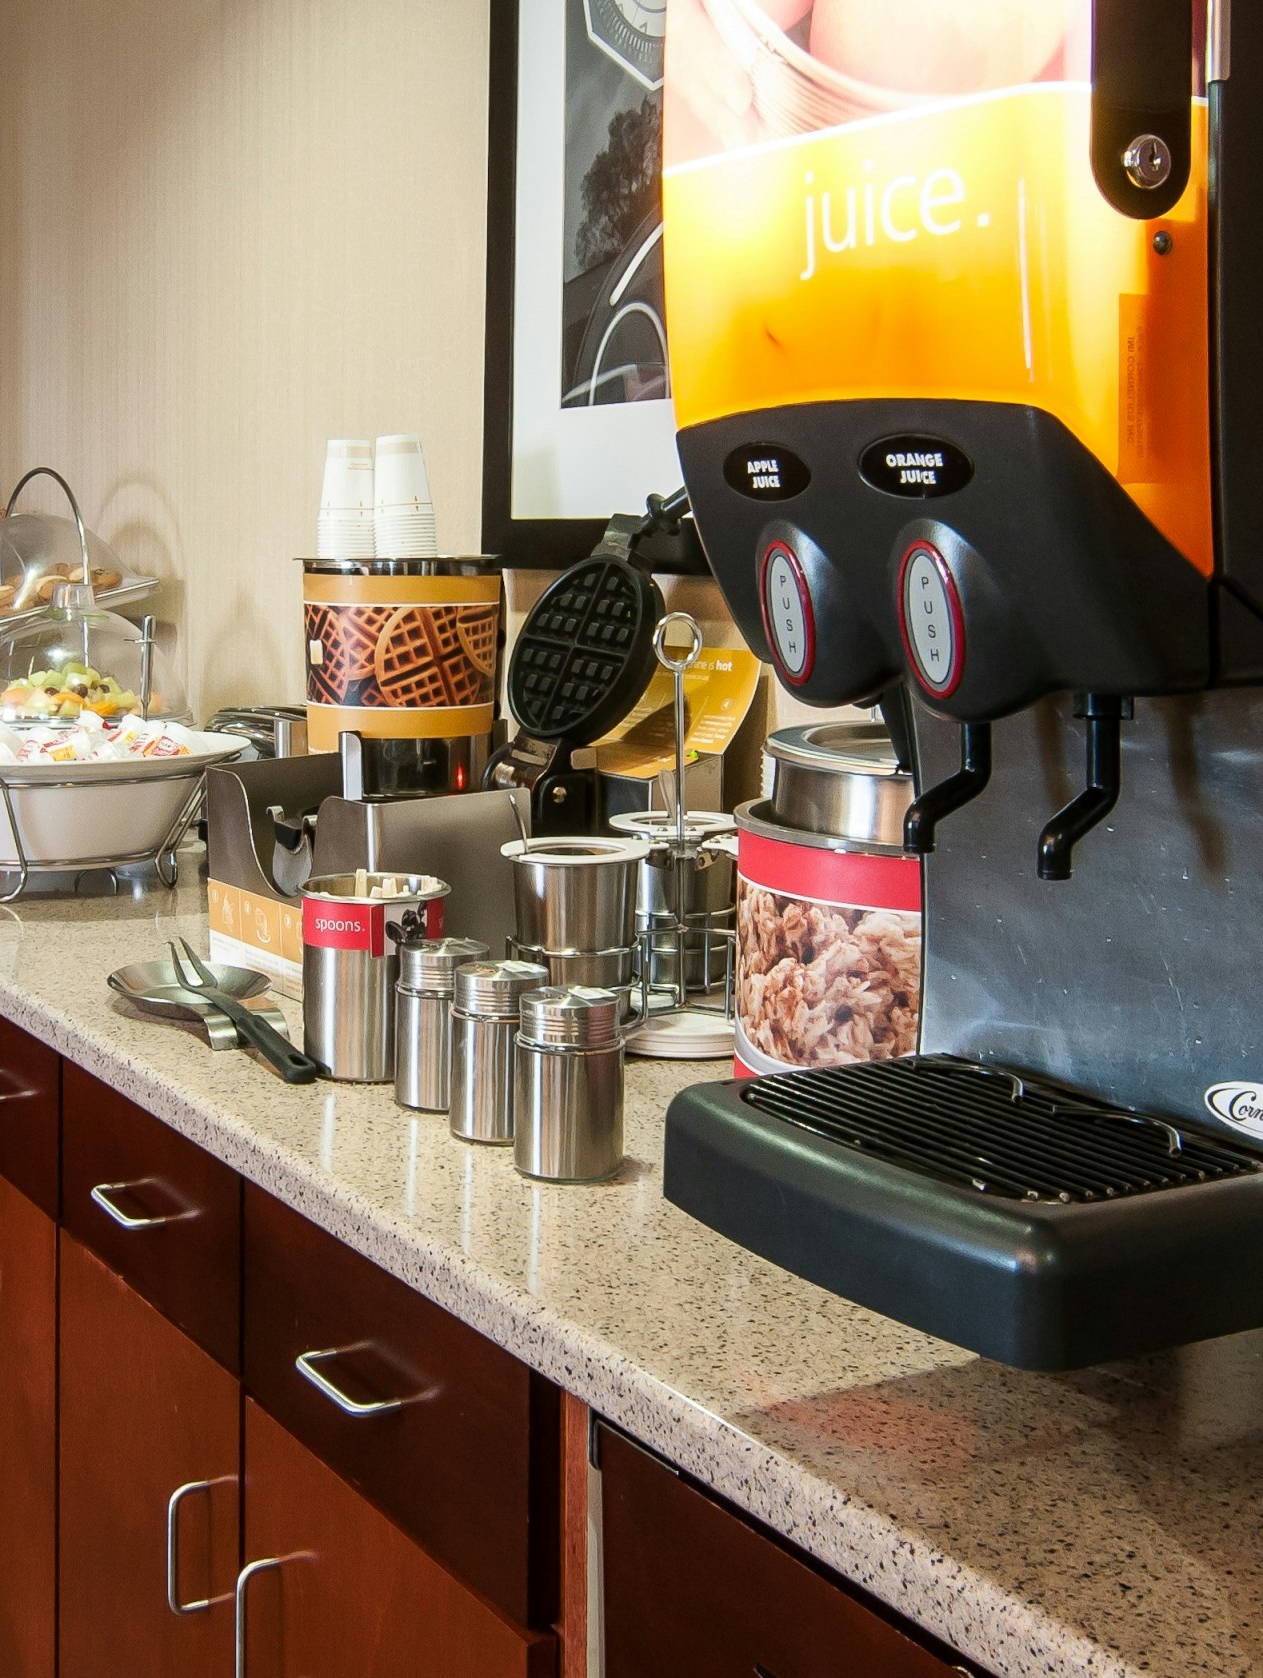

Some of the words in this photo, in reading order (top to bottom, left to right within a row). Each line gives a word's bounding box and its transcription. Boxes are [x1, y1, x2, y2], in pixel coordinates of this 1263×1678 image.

[800, 159, 990, 281] juice.
[747, 459, 779, 473] APPLE
[886, 453, 943, 467] ORANGE
[752, 475, 780, 488] JUICE
[900, 470, 936, 484] JUICE
[779, 575, 797, 653] PUSH
[921, 576, 940, 662] PUSH
[716, 659, 733, 672] hot
[315, 918, 366, 933] spoons.
